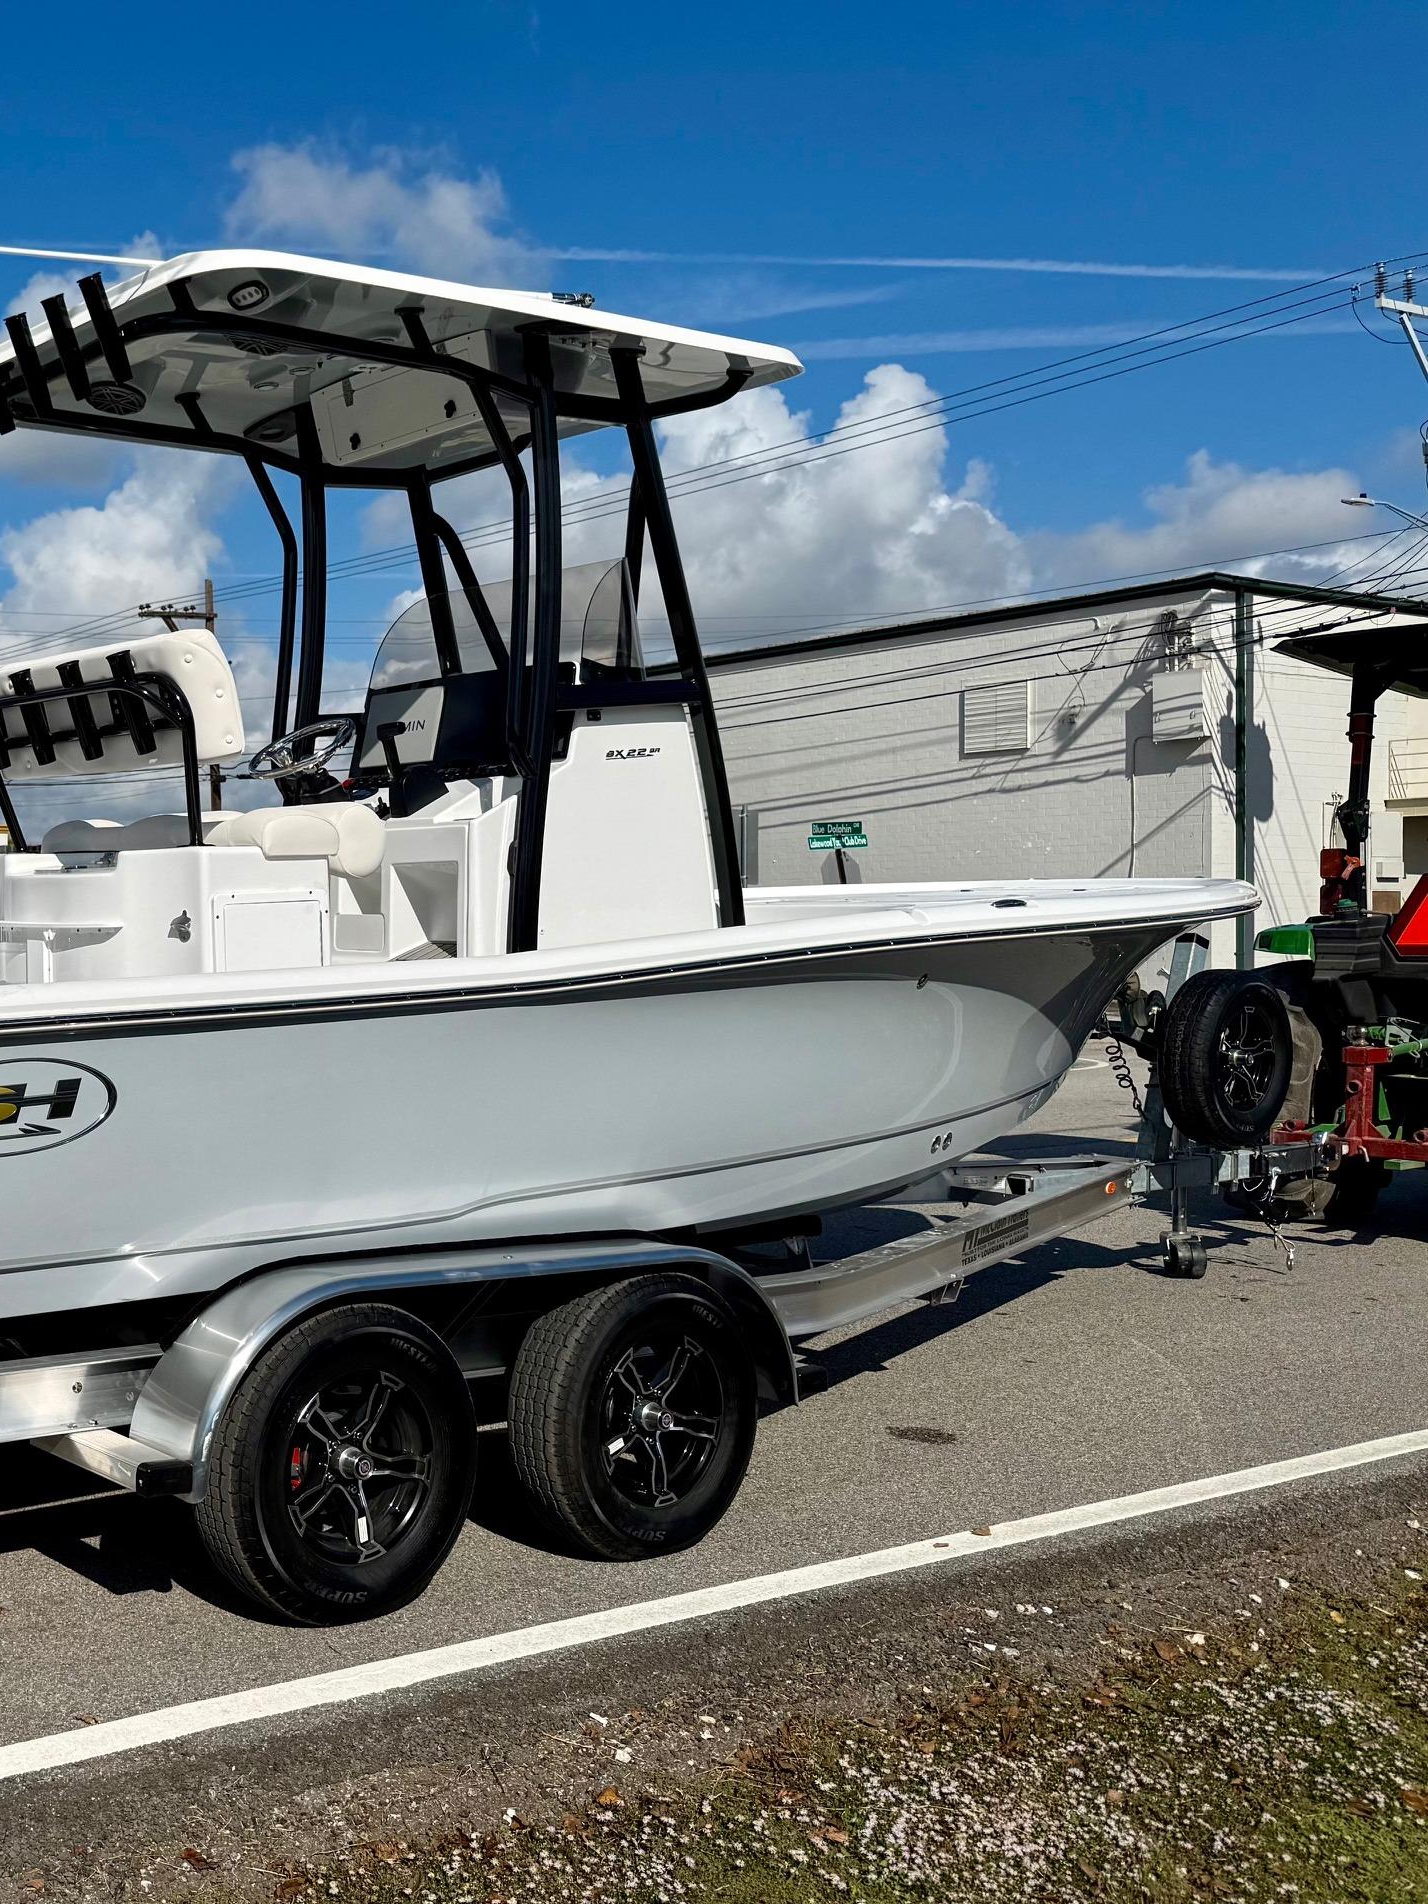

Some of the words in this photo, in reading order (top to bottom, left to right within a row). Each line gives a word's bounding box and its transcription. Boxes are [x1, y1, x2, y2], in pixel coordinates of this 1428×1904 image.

[405, 719, 426, 732] MIN
[813, 824, 824, 833] Blue
[827, 823, 851, 833] Dolphin
[809, 838, 833, 848] Lakewood
[854, 836, 867, 845] Drive
